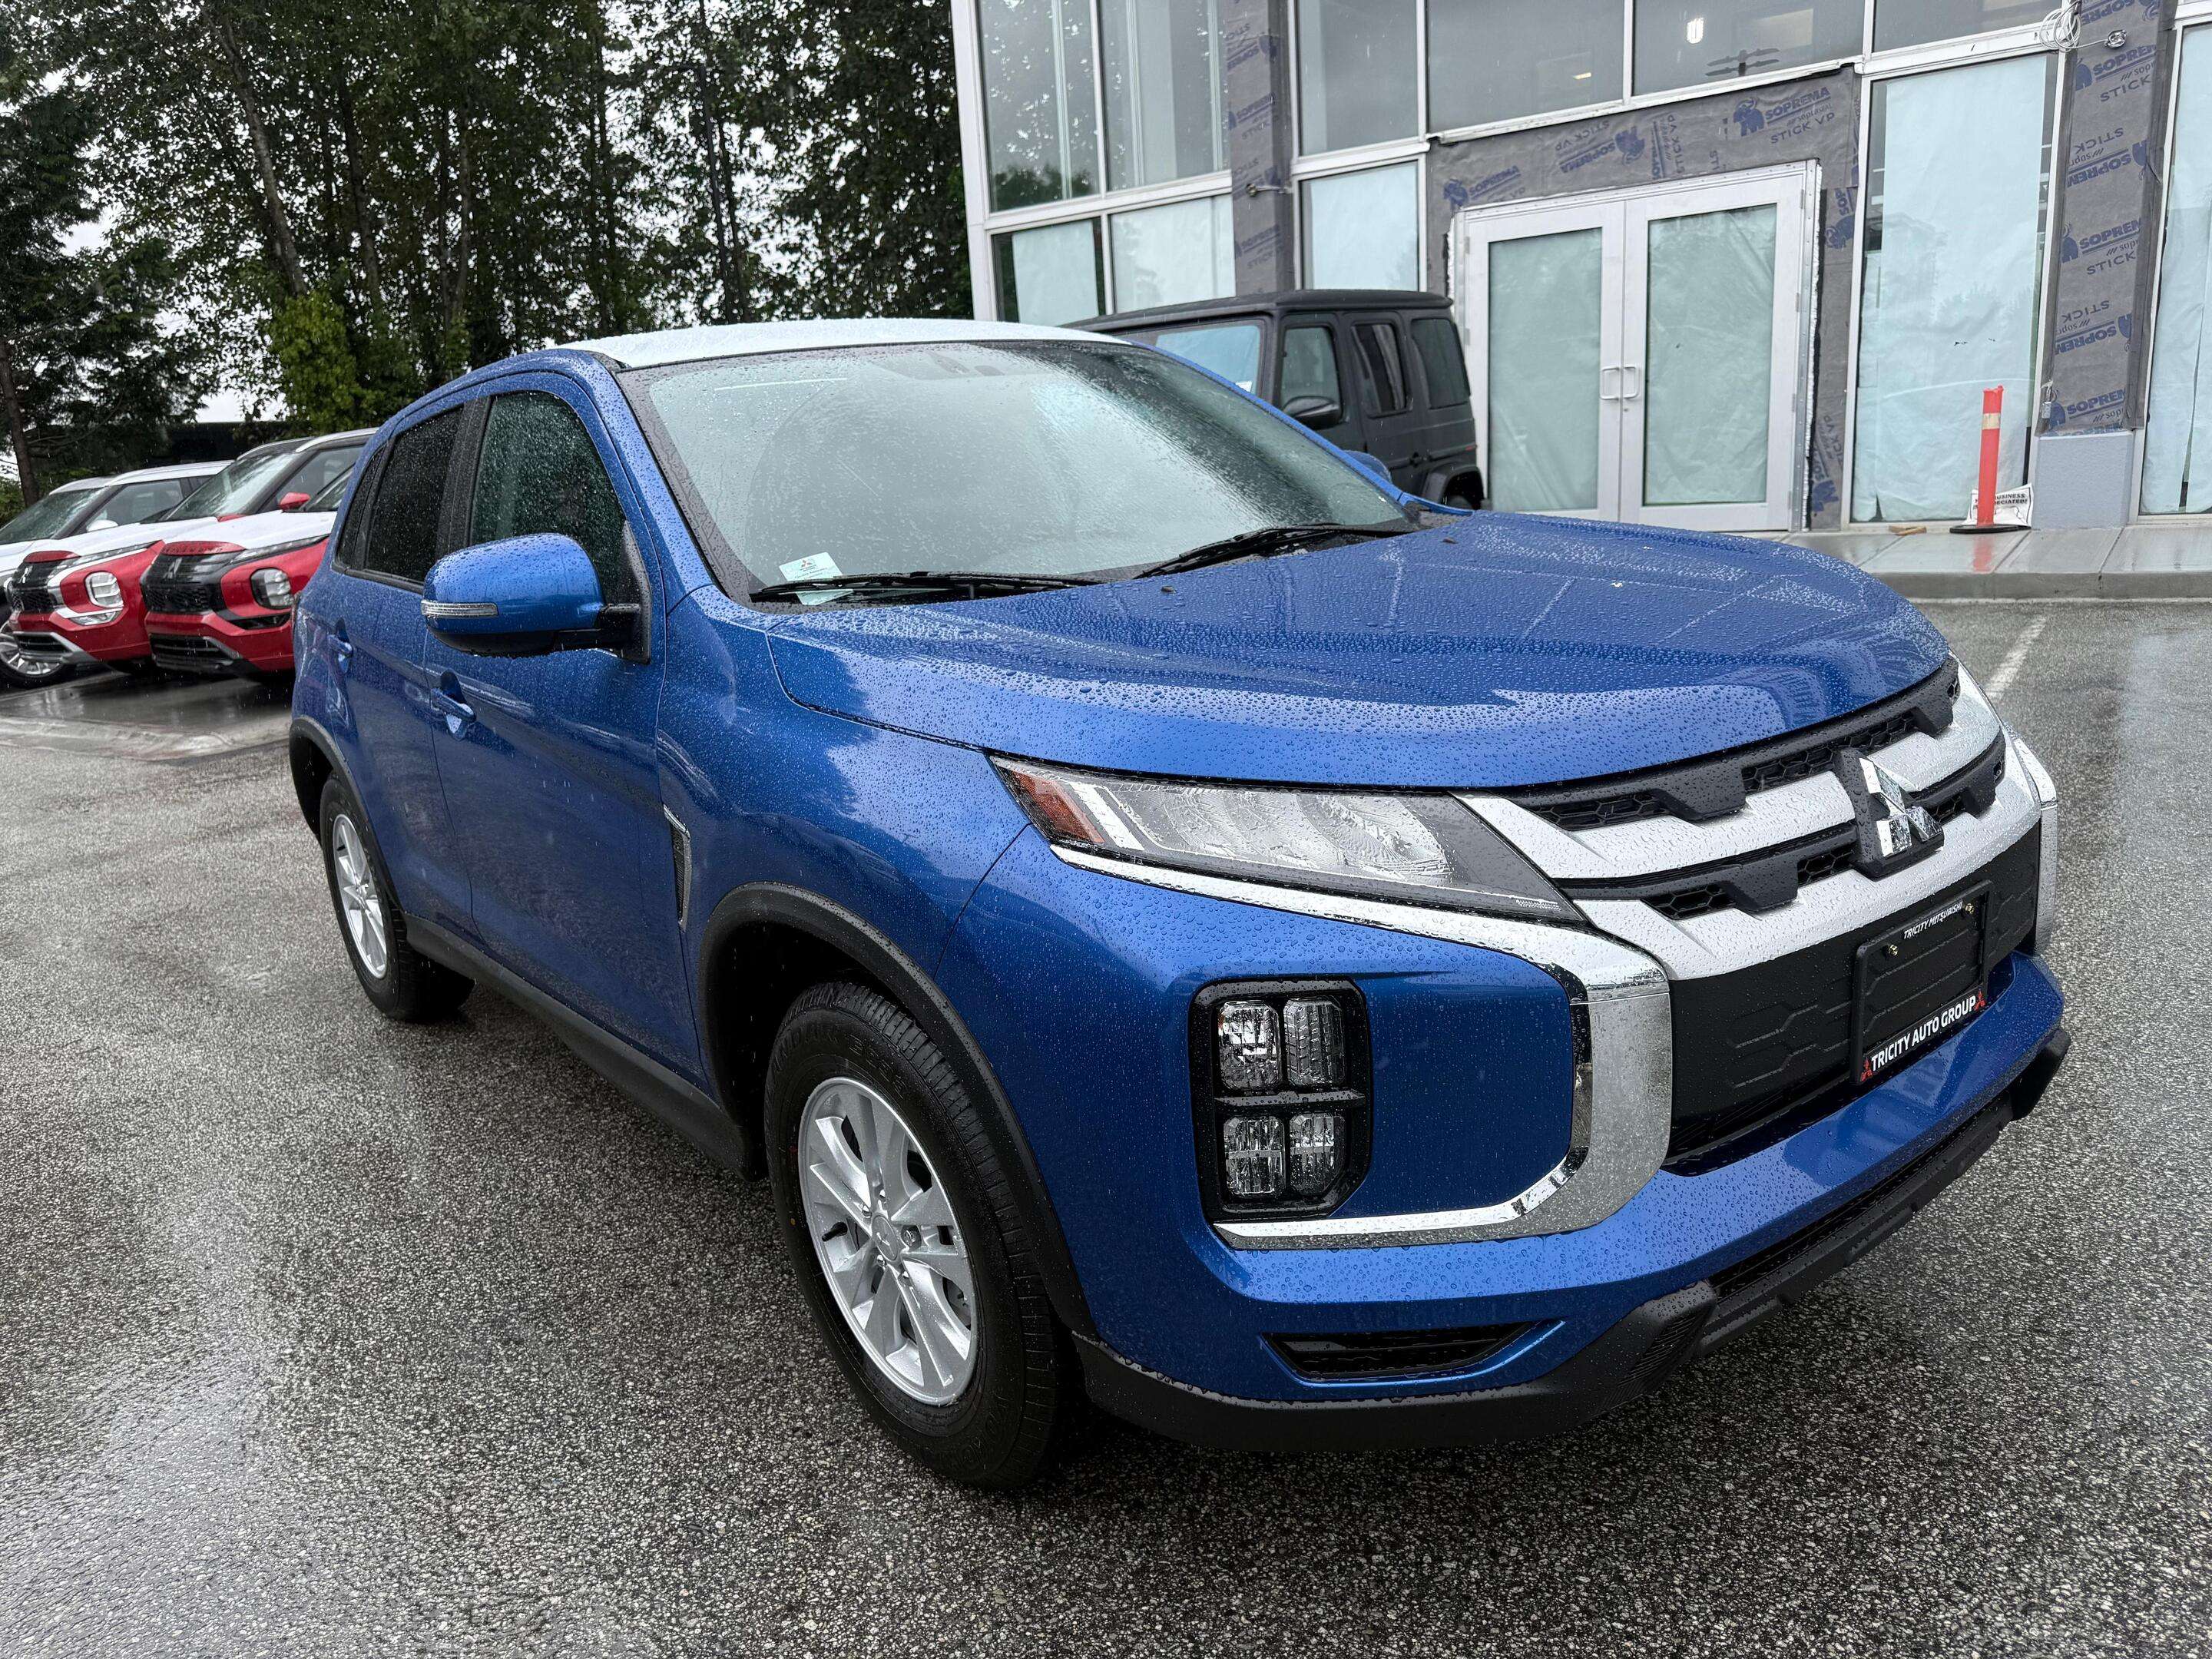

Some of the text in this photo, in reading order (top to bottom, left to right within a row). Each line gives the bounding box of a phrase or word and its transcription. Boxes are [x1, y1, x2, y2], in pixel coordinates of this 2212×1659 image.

[2100, 75, 2151, 102] STICK
[1765, 87, 1830, 120] SOPREMA
[1770, 121, 1812, 144] STICK
[1815, 112, 1835, 125] VP
[2075, 127, 2124, 154] STICK
[2087, 250, 2136, 275] STICK
[2061, 300, 2110, 323] STICK
[1904, 901, 1963, 939] TRICITY MITSUBISHI
[1872, 995, 1976, 1071] TRICITY AUTO GROUP
